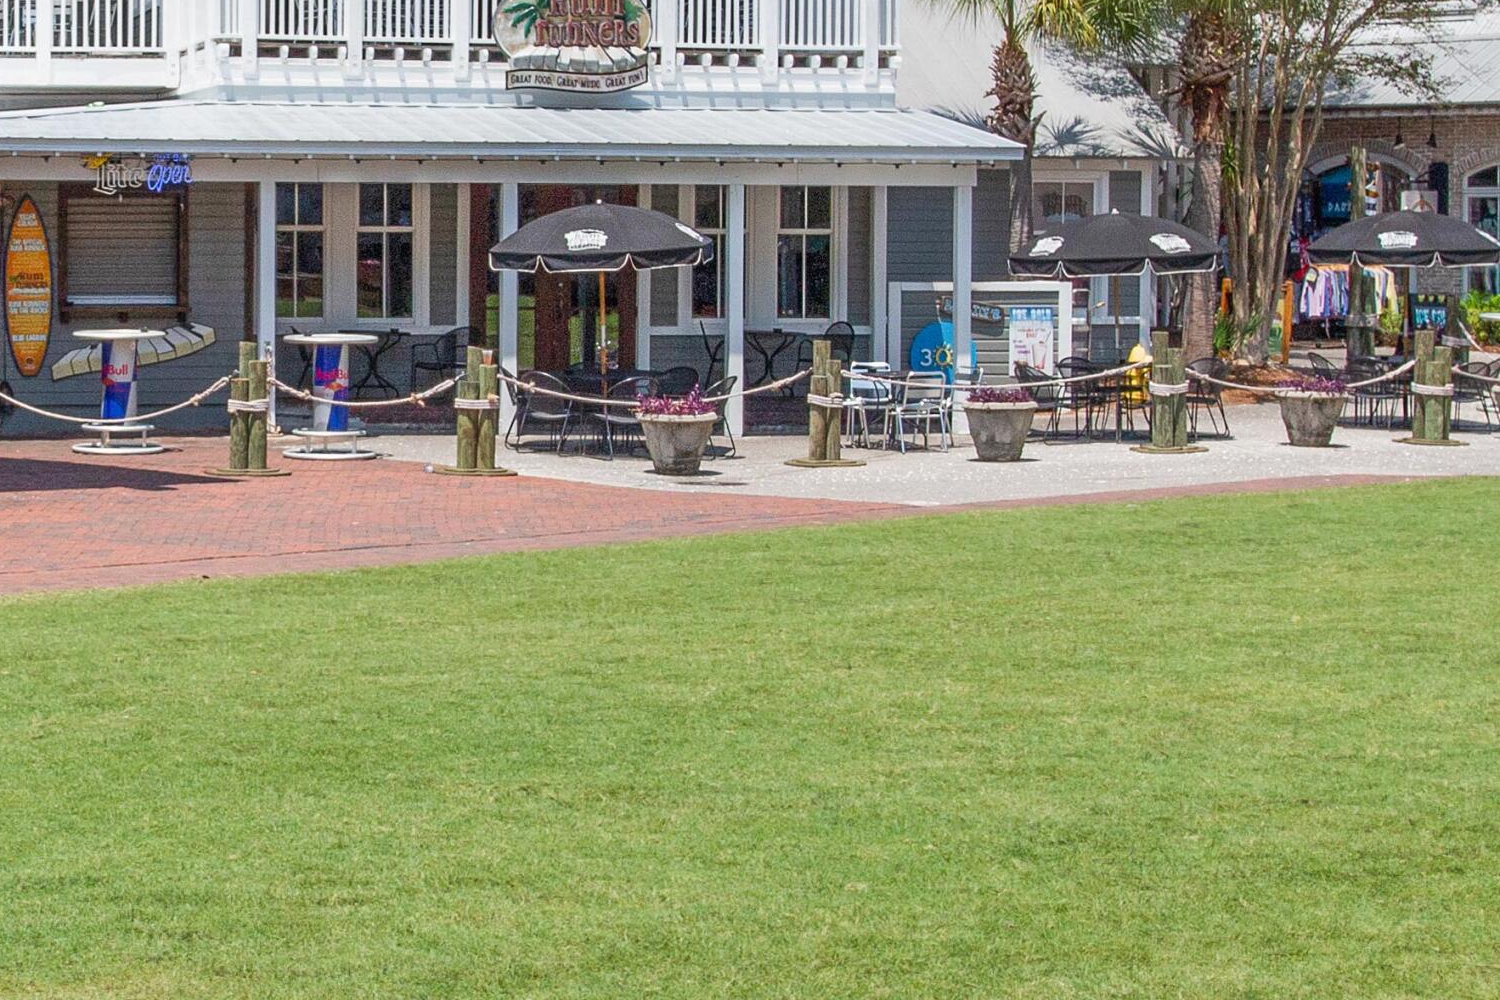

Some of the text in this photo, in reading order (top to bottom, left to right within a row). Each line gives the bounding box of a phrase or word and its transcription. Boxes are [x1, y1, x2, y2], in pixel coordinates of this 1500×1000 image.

[510, 74, 532, 84] GREAT
[557, 75, 578, 88] GREAT
[605, 77, 626, 88] GREAT
[93, 163, 194, 195] Lite Open
